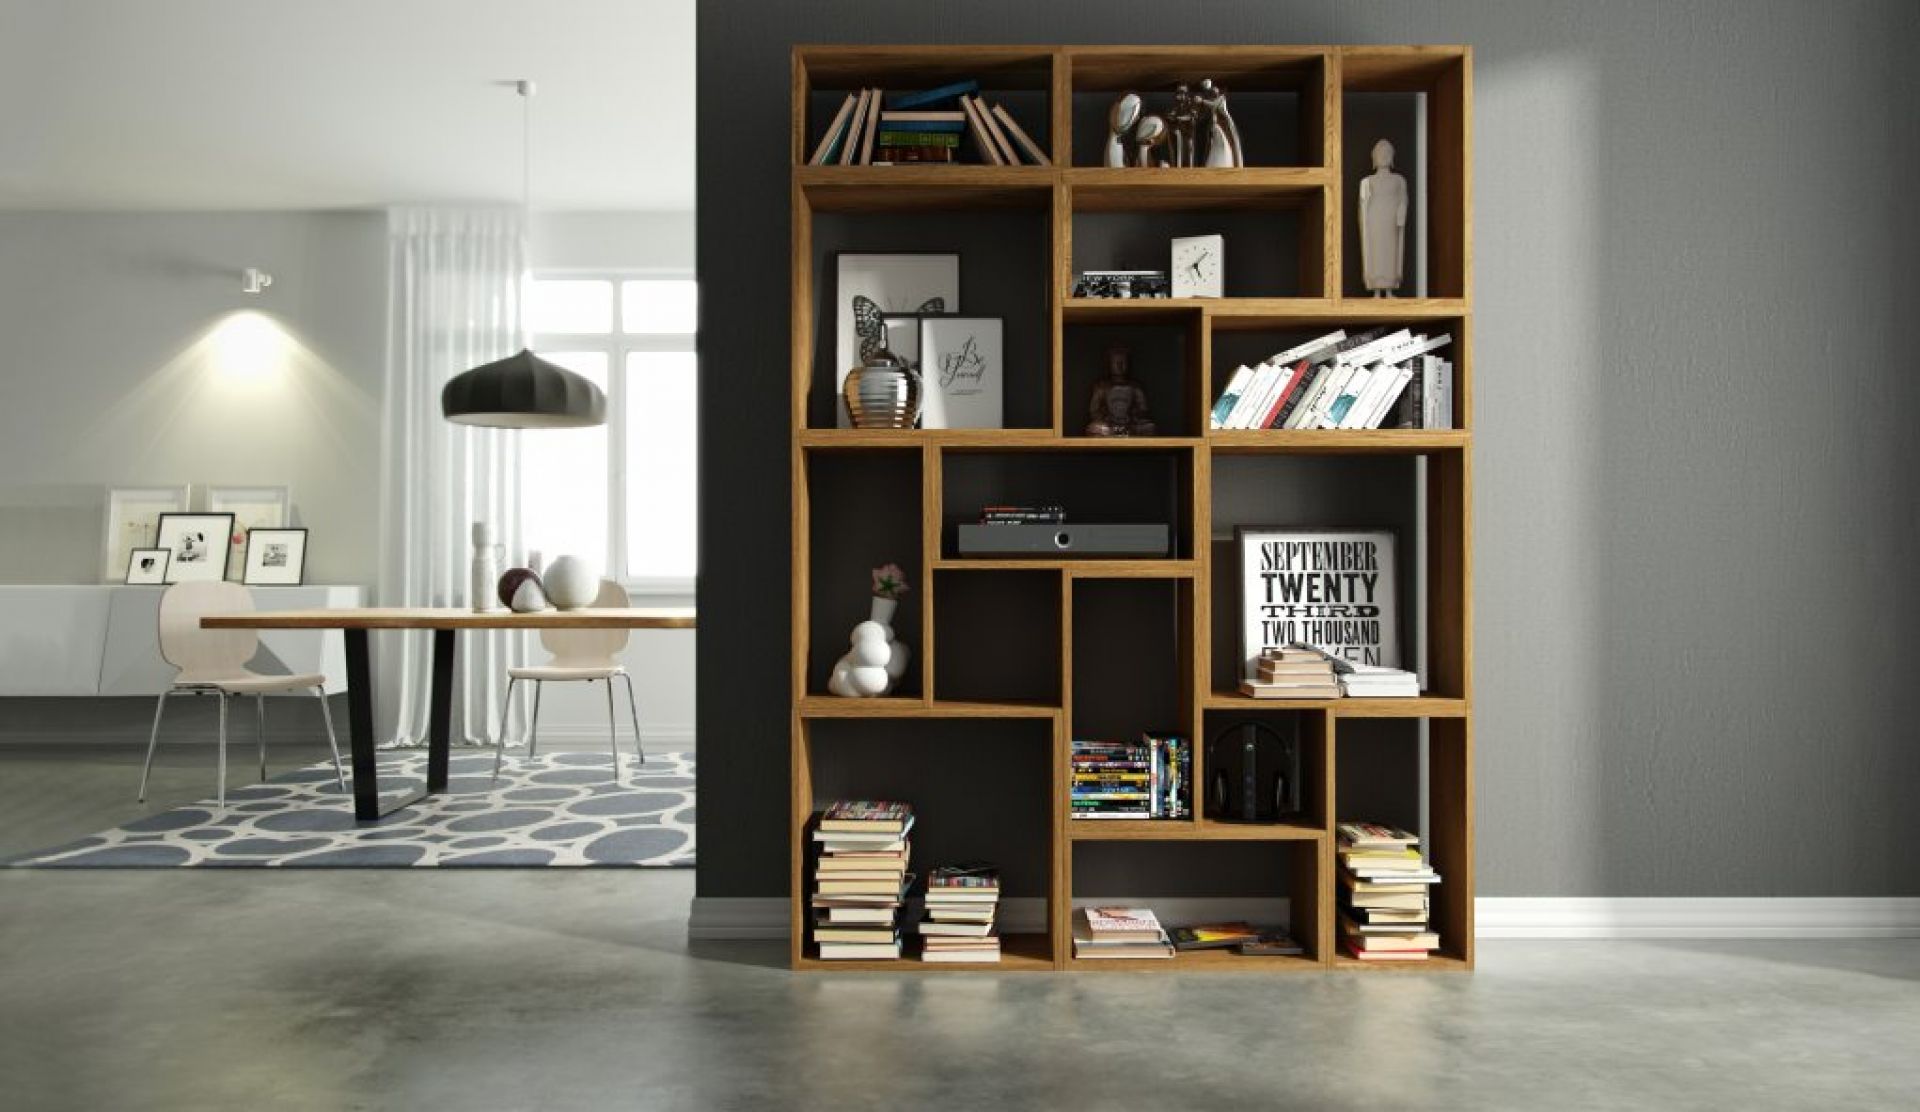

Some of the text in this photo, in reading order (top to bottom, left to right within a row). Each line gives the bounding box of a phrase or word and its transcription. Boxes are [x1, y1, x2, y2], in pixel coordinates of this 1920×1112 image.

[1261, 541, 1378, 571] SEPTEMBER
[1260, 573, 1379, 603] TWENTY
[1260, 605, 1380, 618] THIRD
[1262, 620, 1379, 646] TWO THOUSAND
